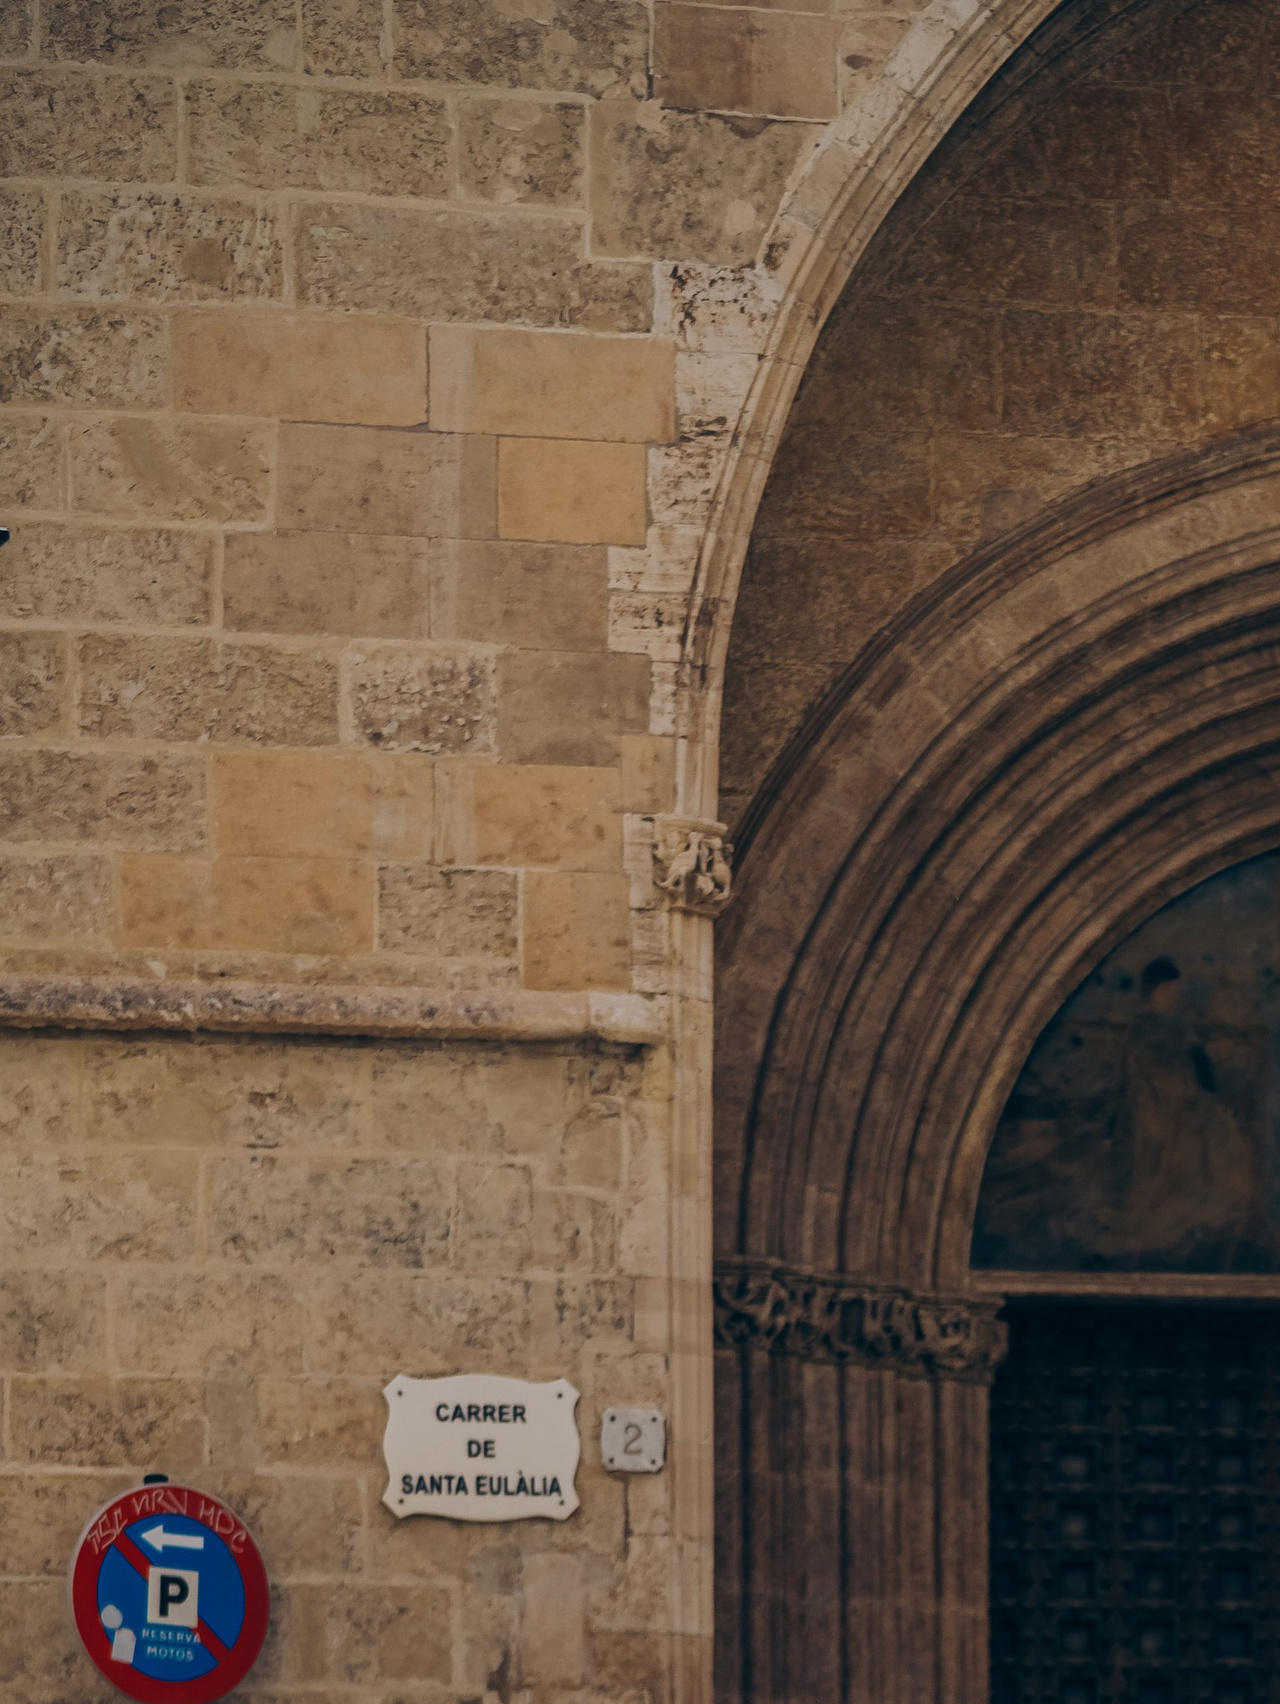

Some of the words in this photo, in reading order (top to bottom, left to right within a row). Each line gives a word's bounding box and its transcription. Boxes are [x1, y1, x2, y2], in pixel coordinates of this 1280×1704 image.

[436, 1403, 527, 1423] CARRER
[467, 1440, 496, 1458] DE
[624, 1424, 643, 1454] 2
[402, 1474, 468, 1496] SANTA
[476, 1471, 562, 1497] EULÀLIA
[159, 1574, 190, 1618] P
[147, 1645, 194, 1662] MOTOS
